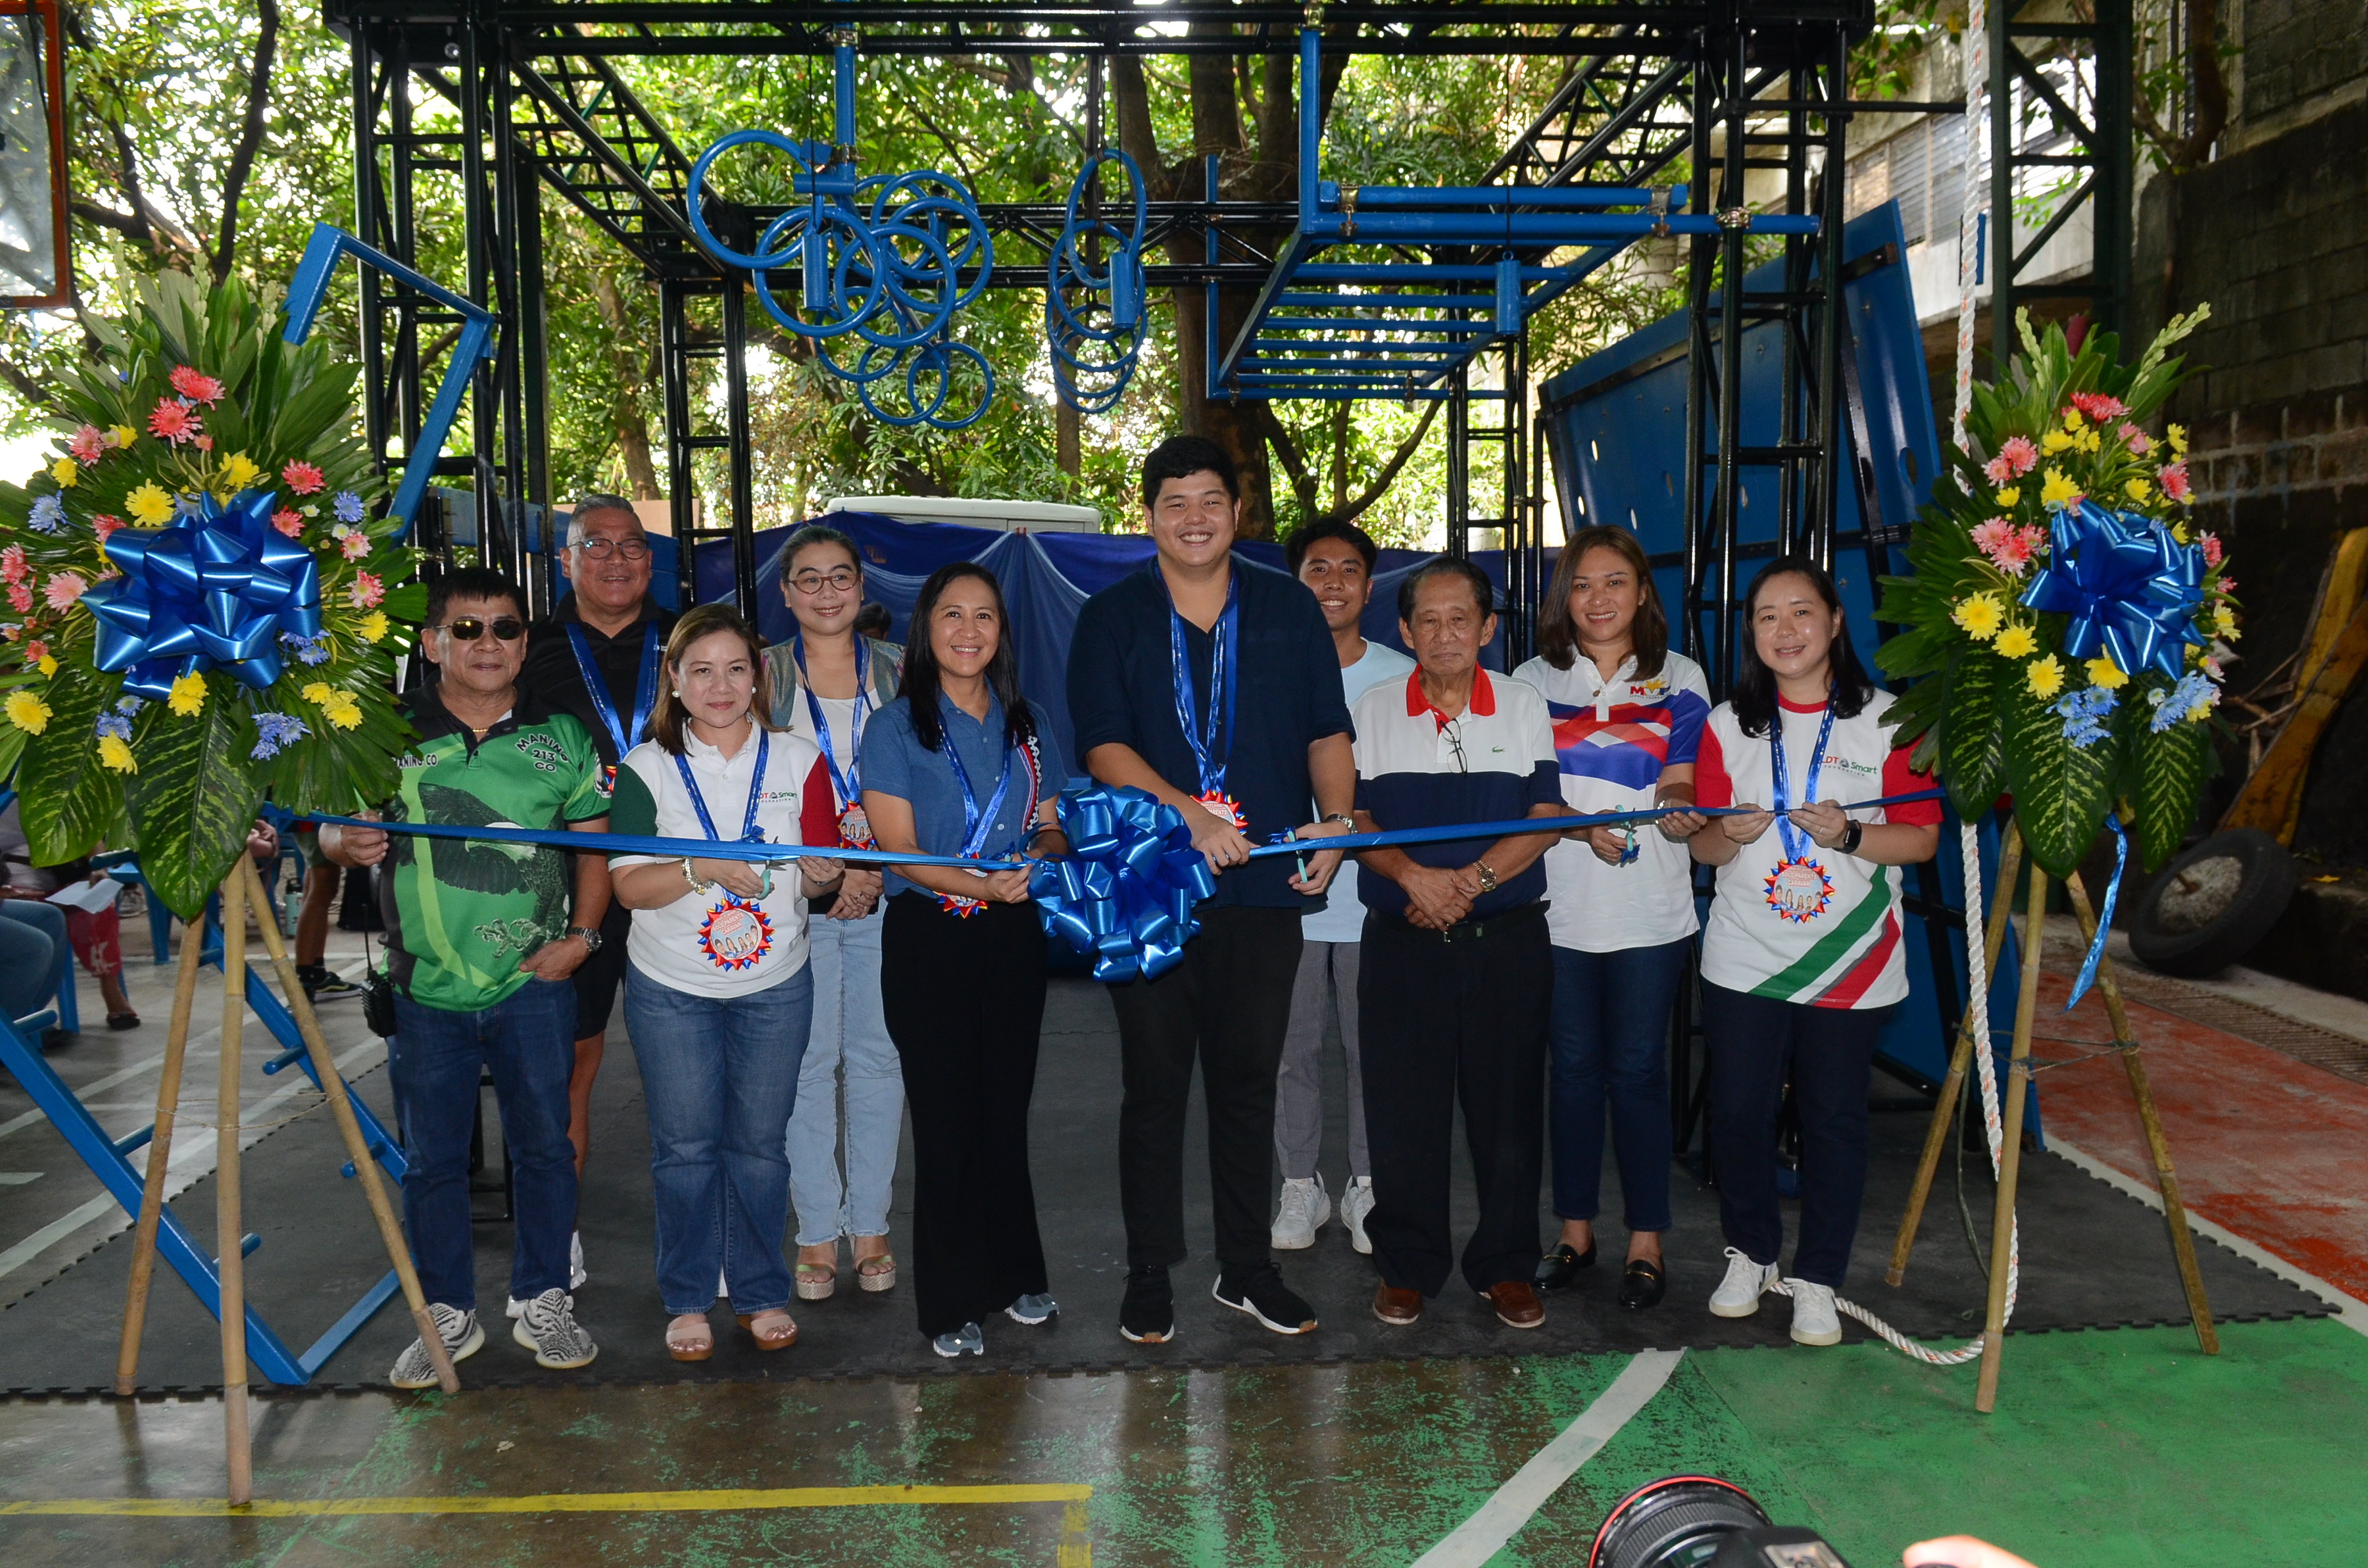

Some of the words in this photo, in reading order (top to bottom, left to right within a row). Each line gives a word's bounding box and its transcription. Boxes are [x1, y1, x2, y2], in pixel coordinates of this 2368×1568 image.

[1630, 685, 1671, 696] MVP
[425, 753, 438, 767] CO
[532, 749, 555, 762] 213
[534, 762, 556, 772] CO
[1851, 762, 1877, 774] Smart
